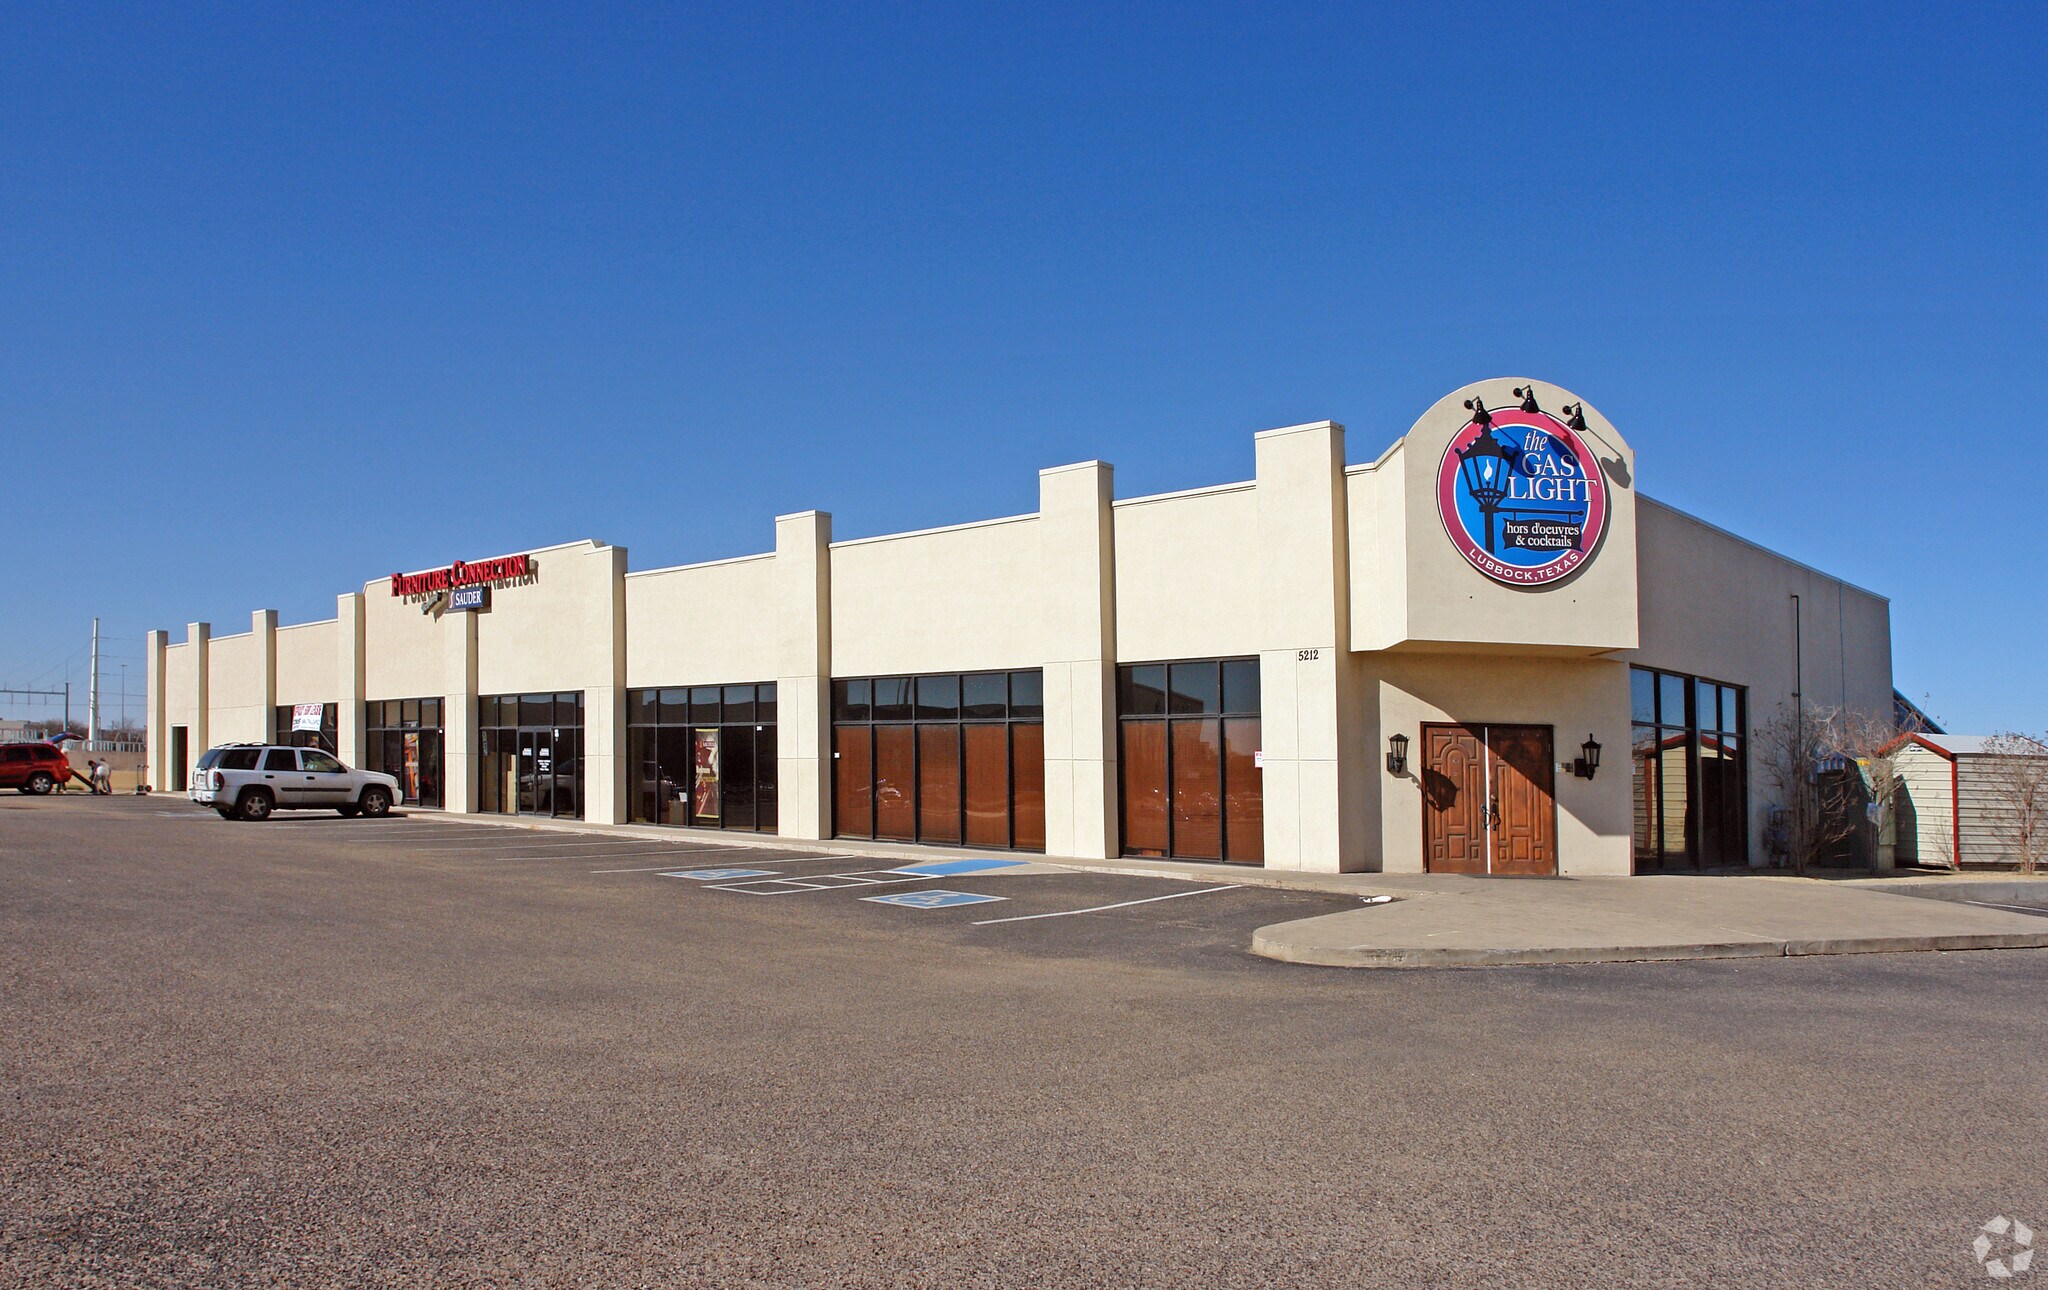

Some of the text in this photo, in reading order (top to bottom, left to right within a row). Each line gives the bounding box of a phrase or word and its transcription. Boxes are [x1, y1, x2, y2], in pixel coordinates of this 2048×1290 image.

[1524, 430, 1548, 452] the
[1521, 452, 1575, 477] GAS
[1507, 476, 1598, 502] LIGHT
[1506, 521, 1580, 536] hors d'oeuvres
[1515, 534, 1572, 547] & cocktails
[391, 554, 530, 597] FURNITURE CONNECTION
[455, 590, 482, 606] SAUDER
[1298, 649, 1319, 662] 5212
